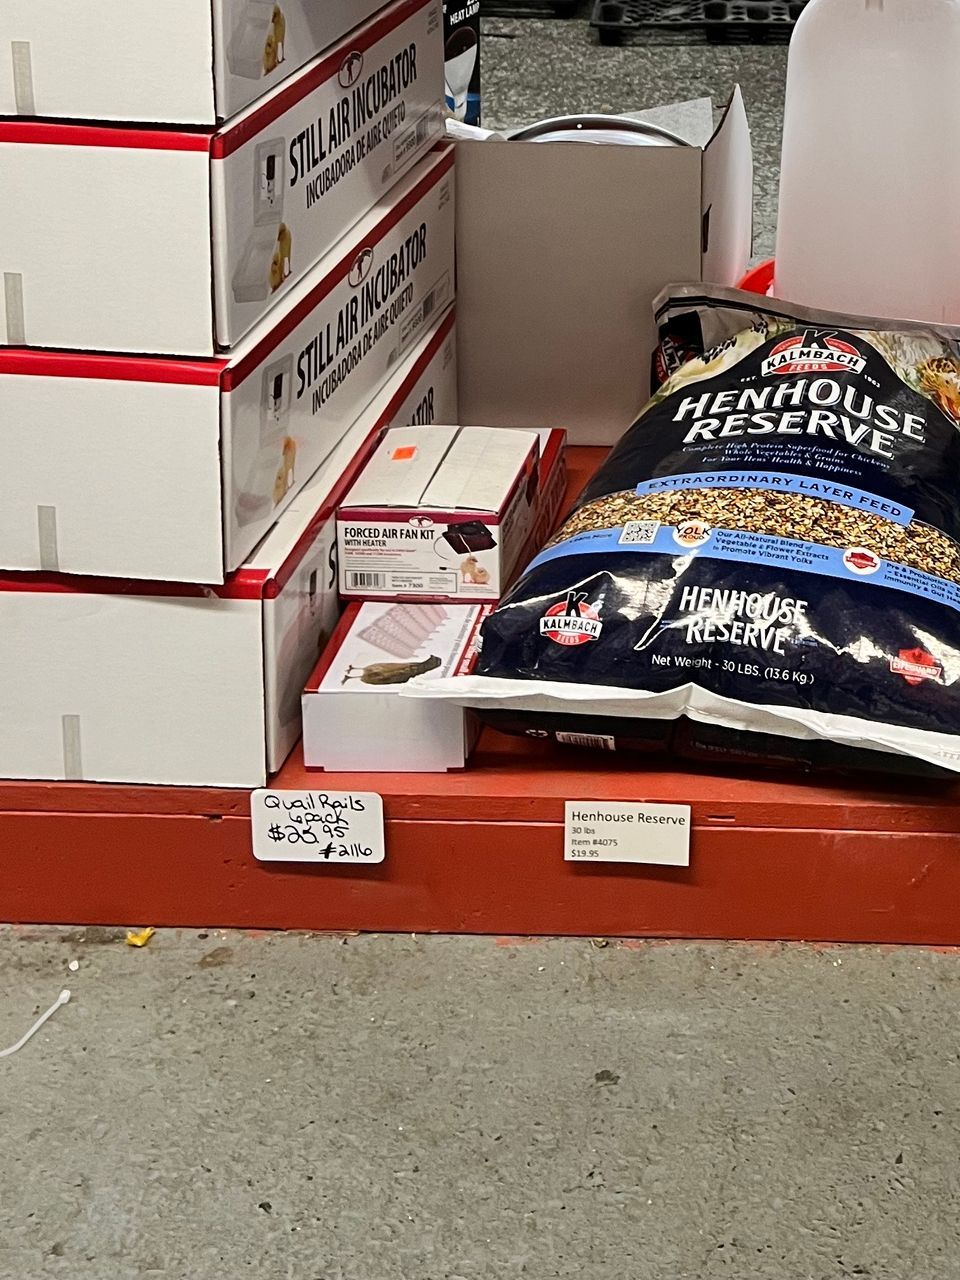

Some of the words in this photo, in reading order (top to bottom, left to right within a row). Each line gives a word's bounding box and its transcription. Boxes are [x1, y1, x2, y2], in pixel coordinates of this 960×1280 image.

[450, 8, 464, 25] HEAT
[290, 117, 326, 187] STILL
[328, 96, 350, 155] AIR
[351, 42, 417, 130] INCUBATOR
[306, 151, 355, 209] INCUBADORA
[297, 323, 334, 400] STILL
[336, 291, 359, 355] AIR
[360, 222, 427, 328] INCUBATOR
[766, 347, 860, 370] KALMBACH
[789, 363, 828, 372] FEEDS
[312, 342, 362, 416] INCUBADORA
[672, 377, 927, 443] HENHOUSE
[682, 409, 896, 461] RESERVE
[648, 474, 794, 489] EXTRAORDINARY
[799, 480, 854, 500] LAYER
[858, 496, 902, 517] FEED
[344, 528, 380, 539] FORCED
[382, 528, 398, 539] AIR
[399, 529, 418, 540] FAN
[420, 529, 435, 540] KIT
[679, 585, 808, 626] HENHOUSE
[543, 618, 598, 634] KALMBACH
[686, 621, 787, 656] RESERVE
[652, 654, 671, 666] Net
[674, 656, 712, 670] Weight
[722, 661, 735, 672] 30
[738, 663, 762, 677] LBS.
[764, 667, 790, 681] (13.6
[264, 793, 316, 811] Quail
[319, 794, 366, 811] Rails
[304, 810, 349, 826] pack
[571, 810, 633, 825] Henhouse
[637, 812, 686, 826] Reserve
[571, 827, 581, 835] 30
[583, 826, 596, 835] lbs
[319, 842, 373, 859] #2116
[571, 837, 588, 846] Item
[590, 838, 618, 847] #4075
[571, 849, 600, 858] $19.95
